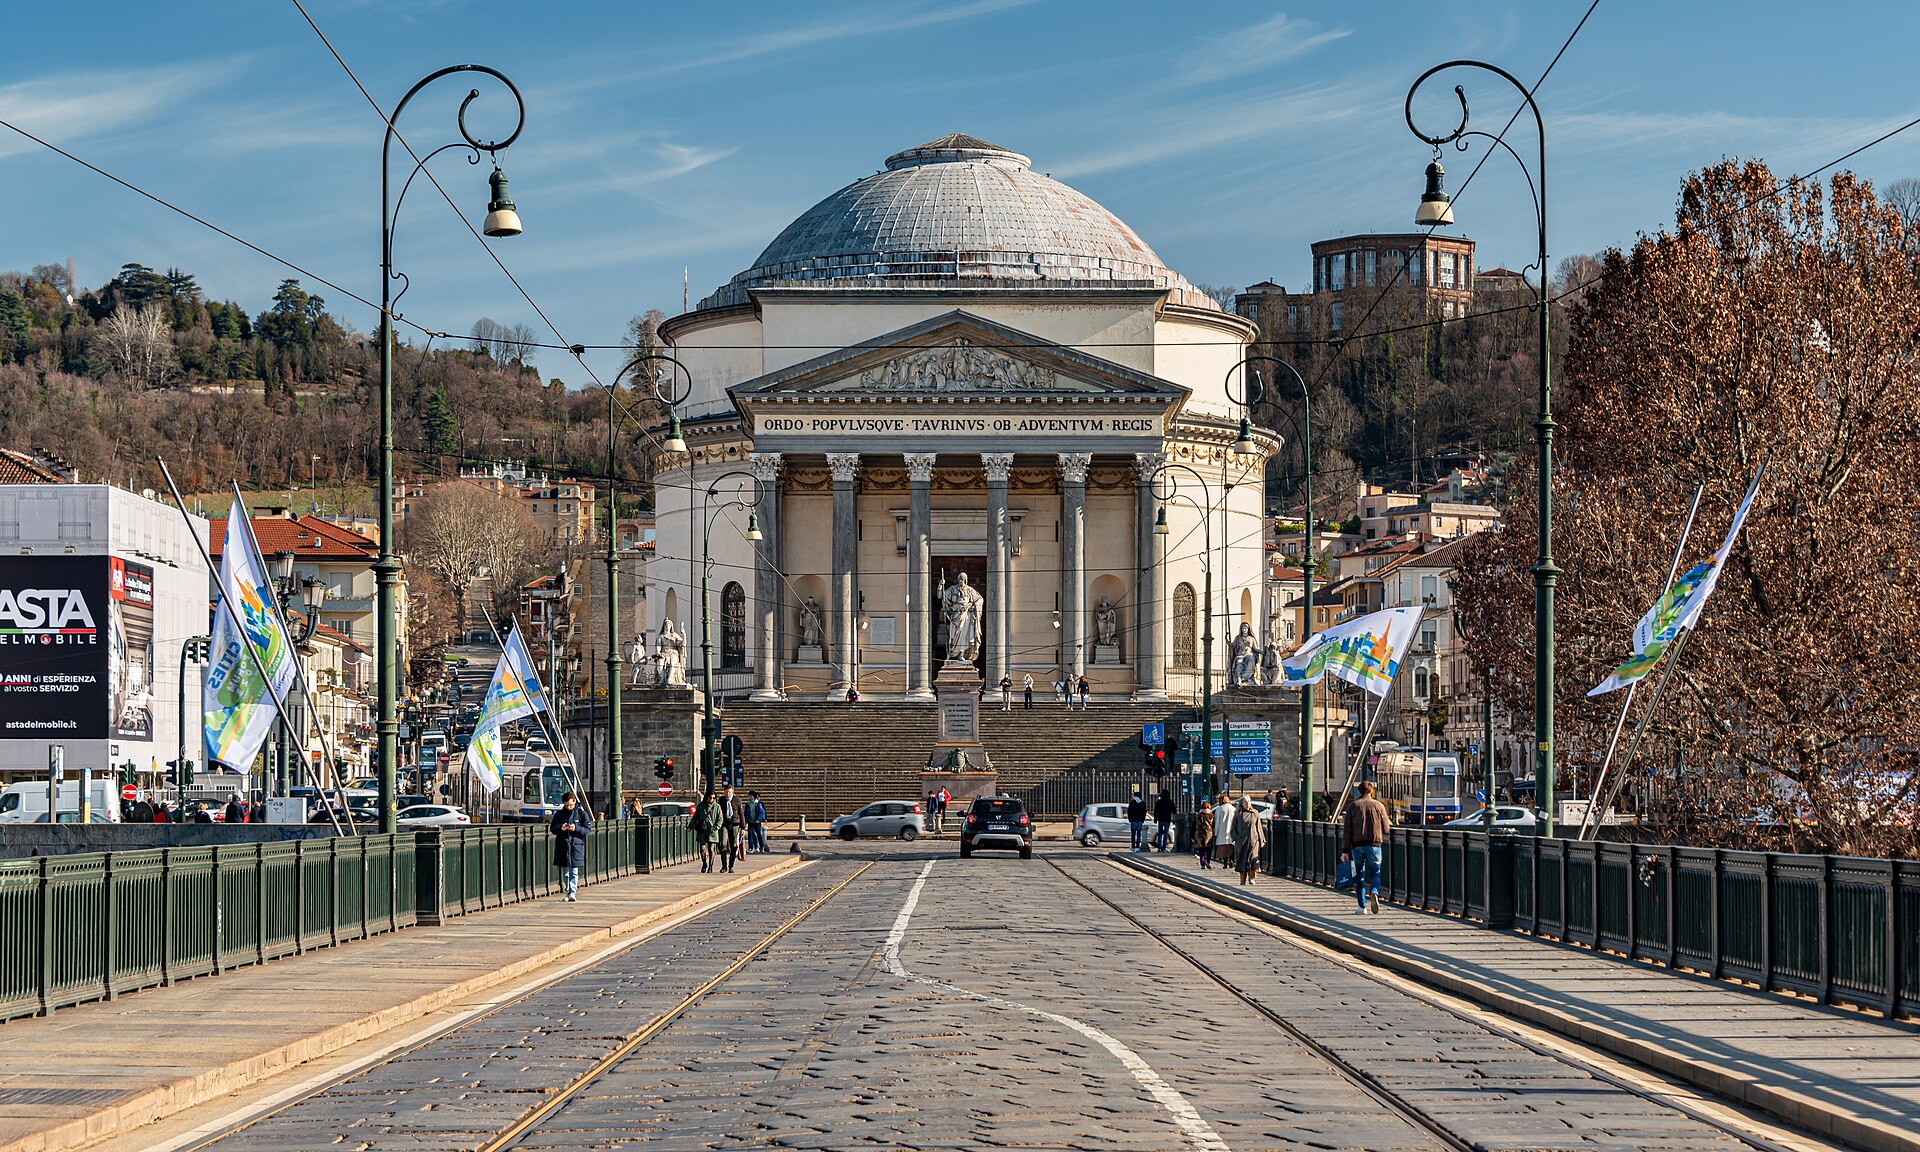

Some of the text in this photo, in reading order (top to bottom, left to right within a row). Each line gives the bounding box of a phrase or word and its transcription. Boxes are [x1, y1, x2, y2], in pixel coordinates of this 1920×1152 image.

[764, 419, 1153, 433] ORDO POPVLVSQVE TAVRINVS OB ADVENTVM REGIS
[0, 589, 96, 628] ASTA
[5, 674, 31, 683] ANNI
[33, 675, 42, 683] di
[43, 675, 97, 683] ESPERIENZA
[4, 684, 80, 693] al vostro SERVIZIO
[6, 720, 77, 729] astadelmobile.it
